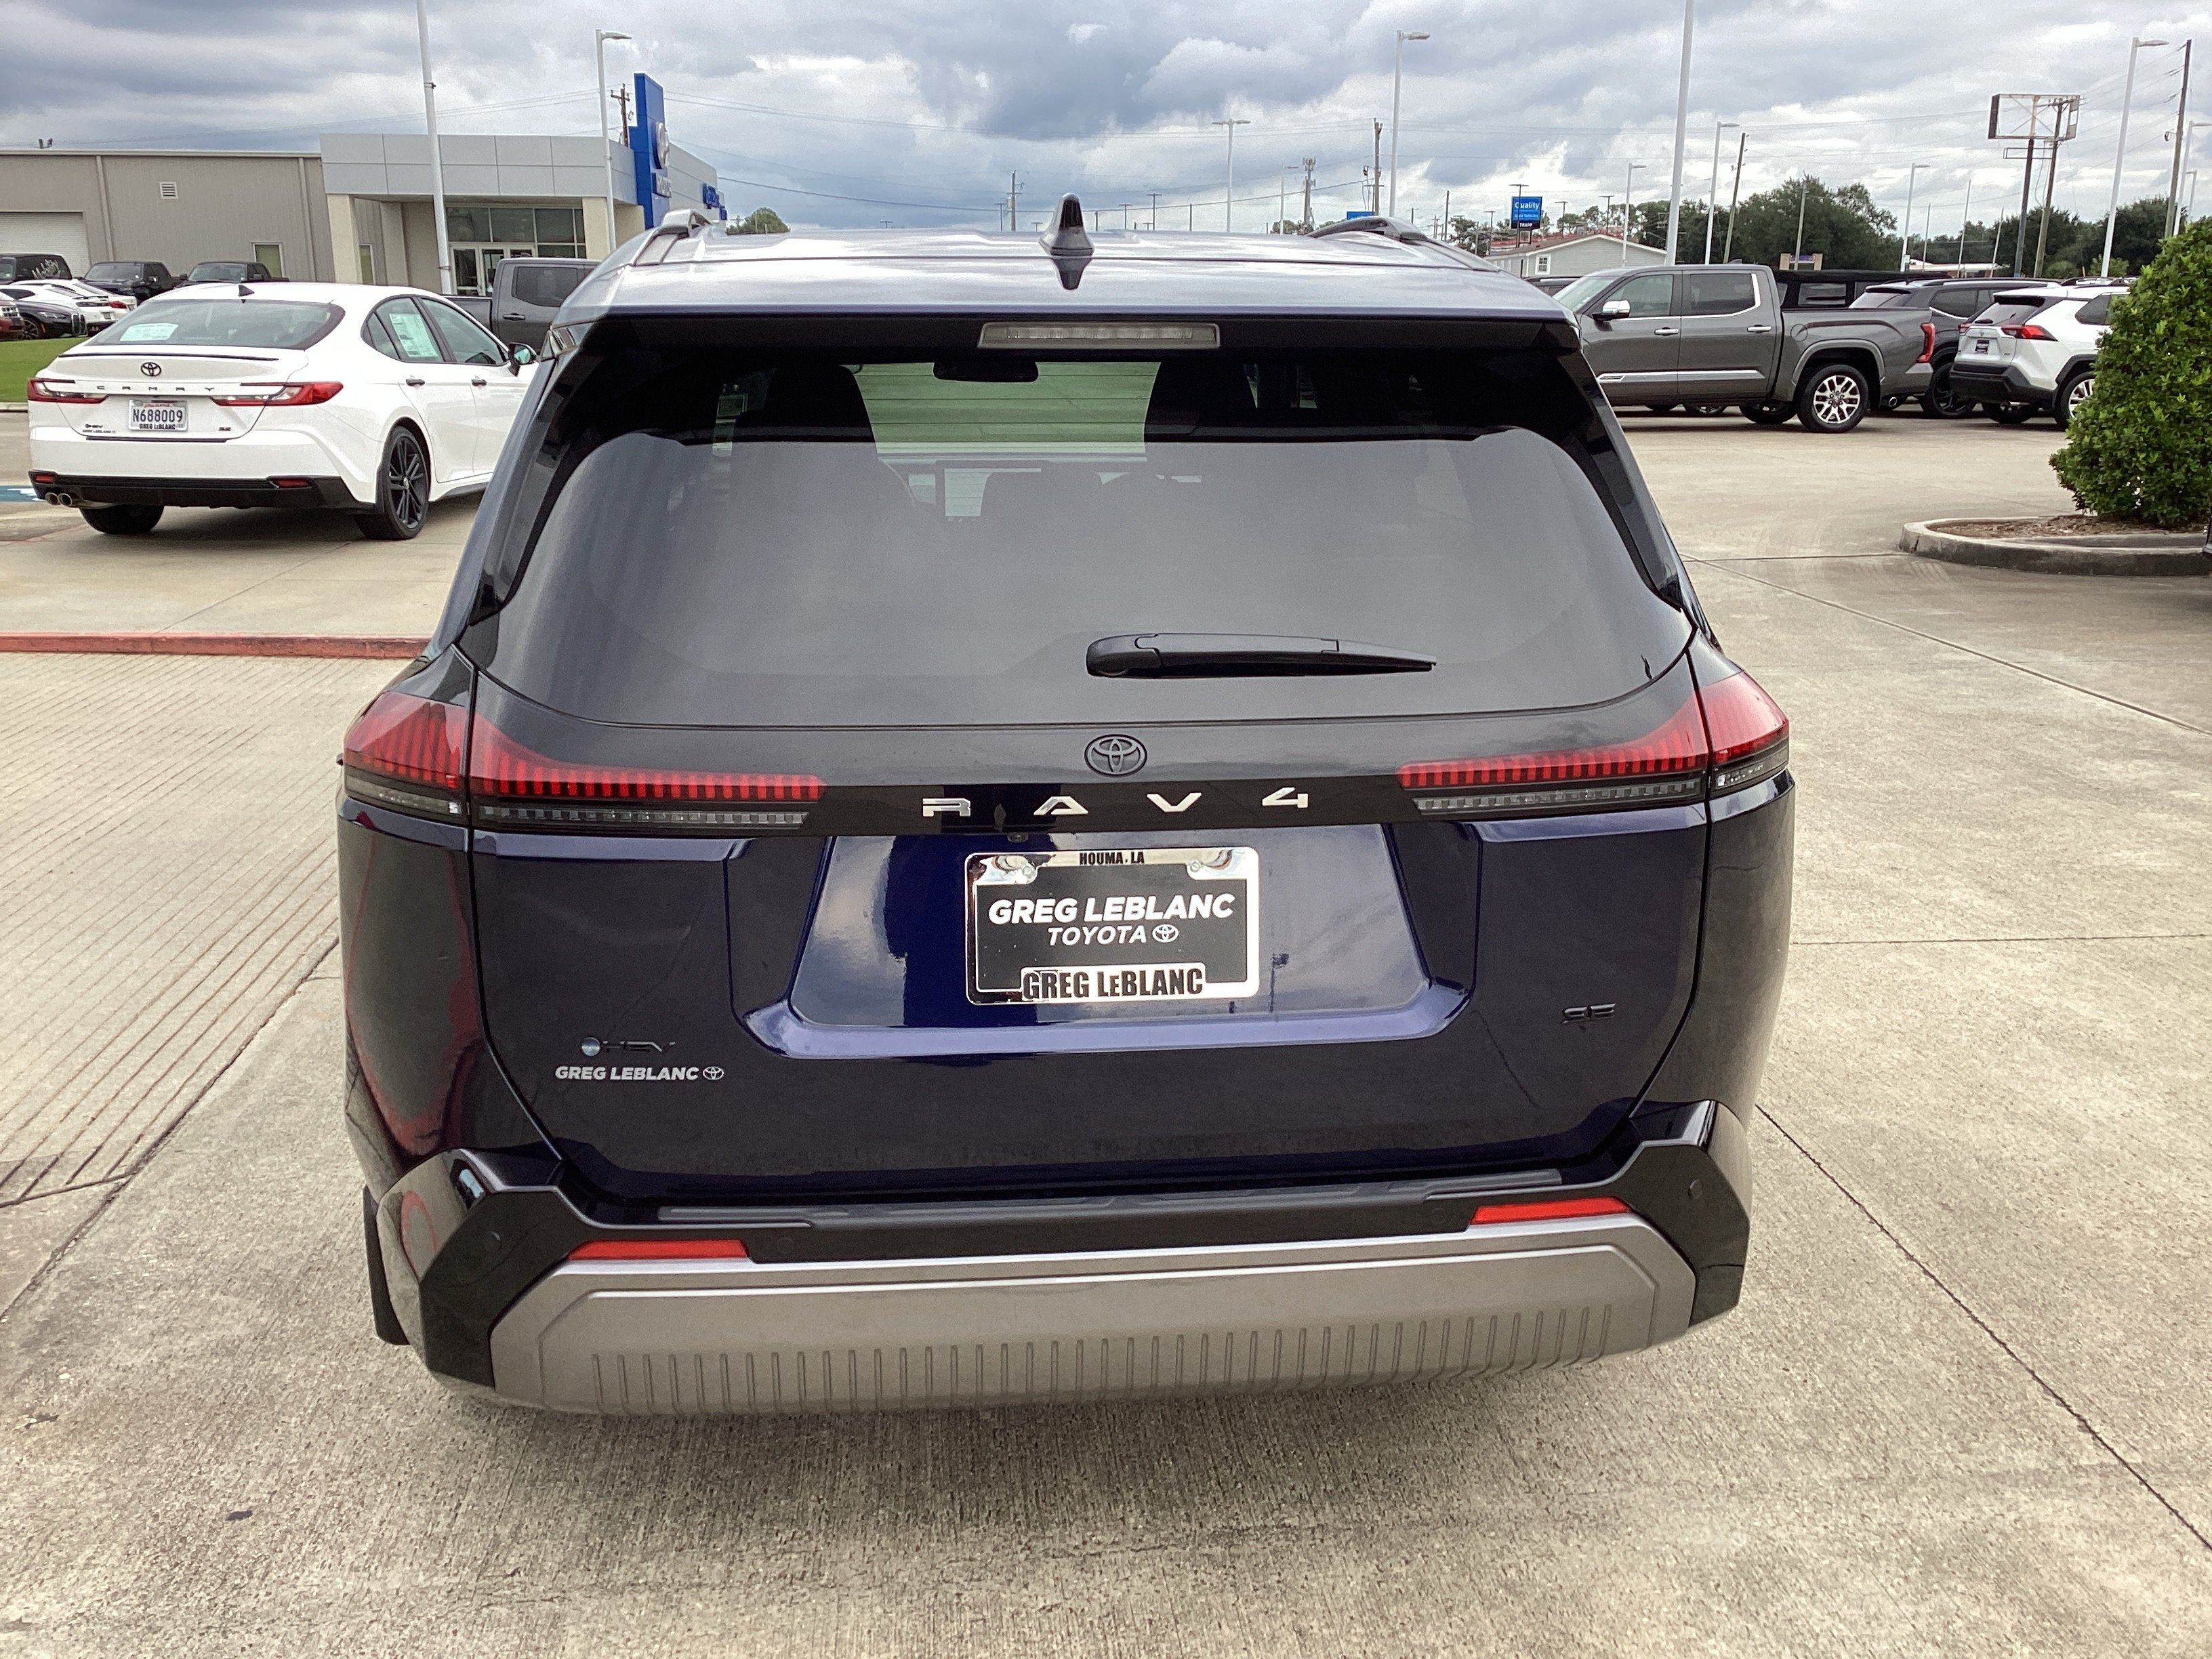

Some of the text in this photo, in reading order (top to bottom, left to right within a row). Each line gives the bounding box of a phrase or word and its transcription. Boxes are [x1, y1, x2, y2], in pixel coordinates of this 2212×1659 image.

[132, 409, 183, 423] N688009
[922, 787, 1309, 817] RAV4
[1130, 851, 1145, 864] LA
[988, 893, 1235, 924] GREG LEBLANC
[1048, 924, 1147, 946] TOYOTA
[1022, 970, 1090, 1000] GREG
[554, 1065, 699, 1081] GREG LEBLANC
